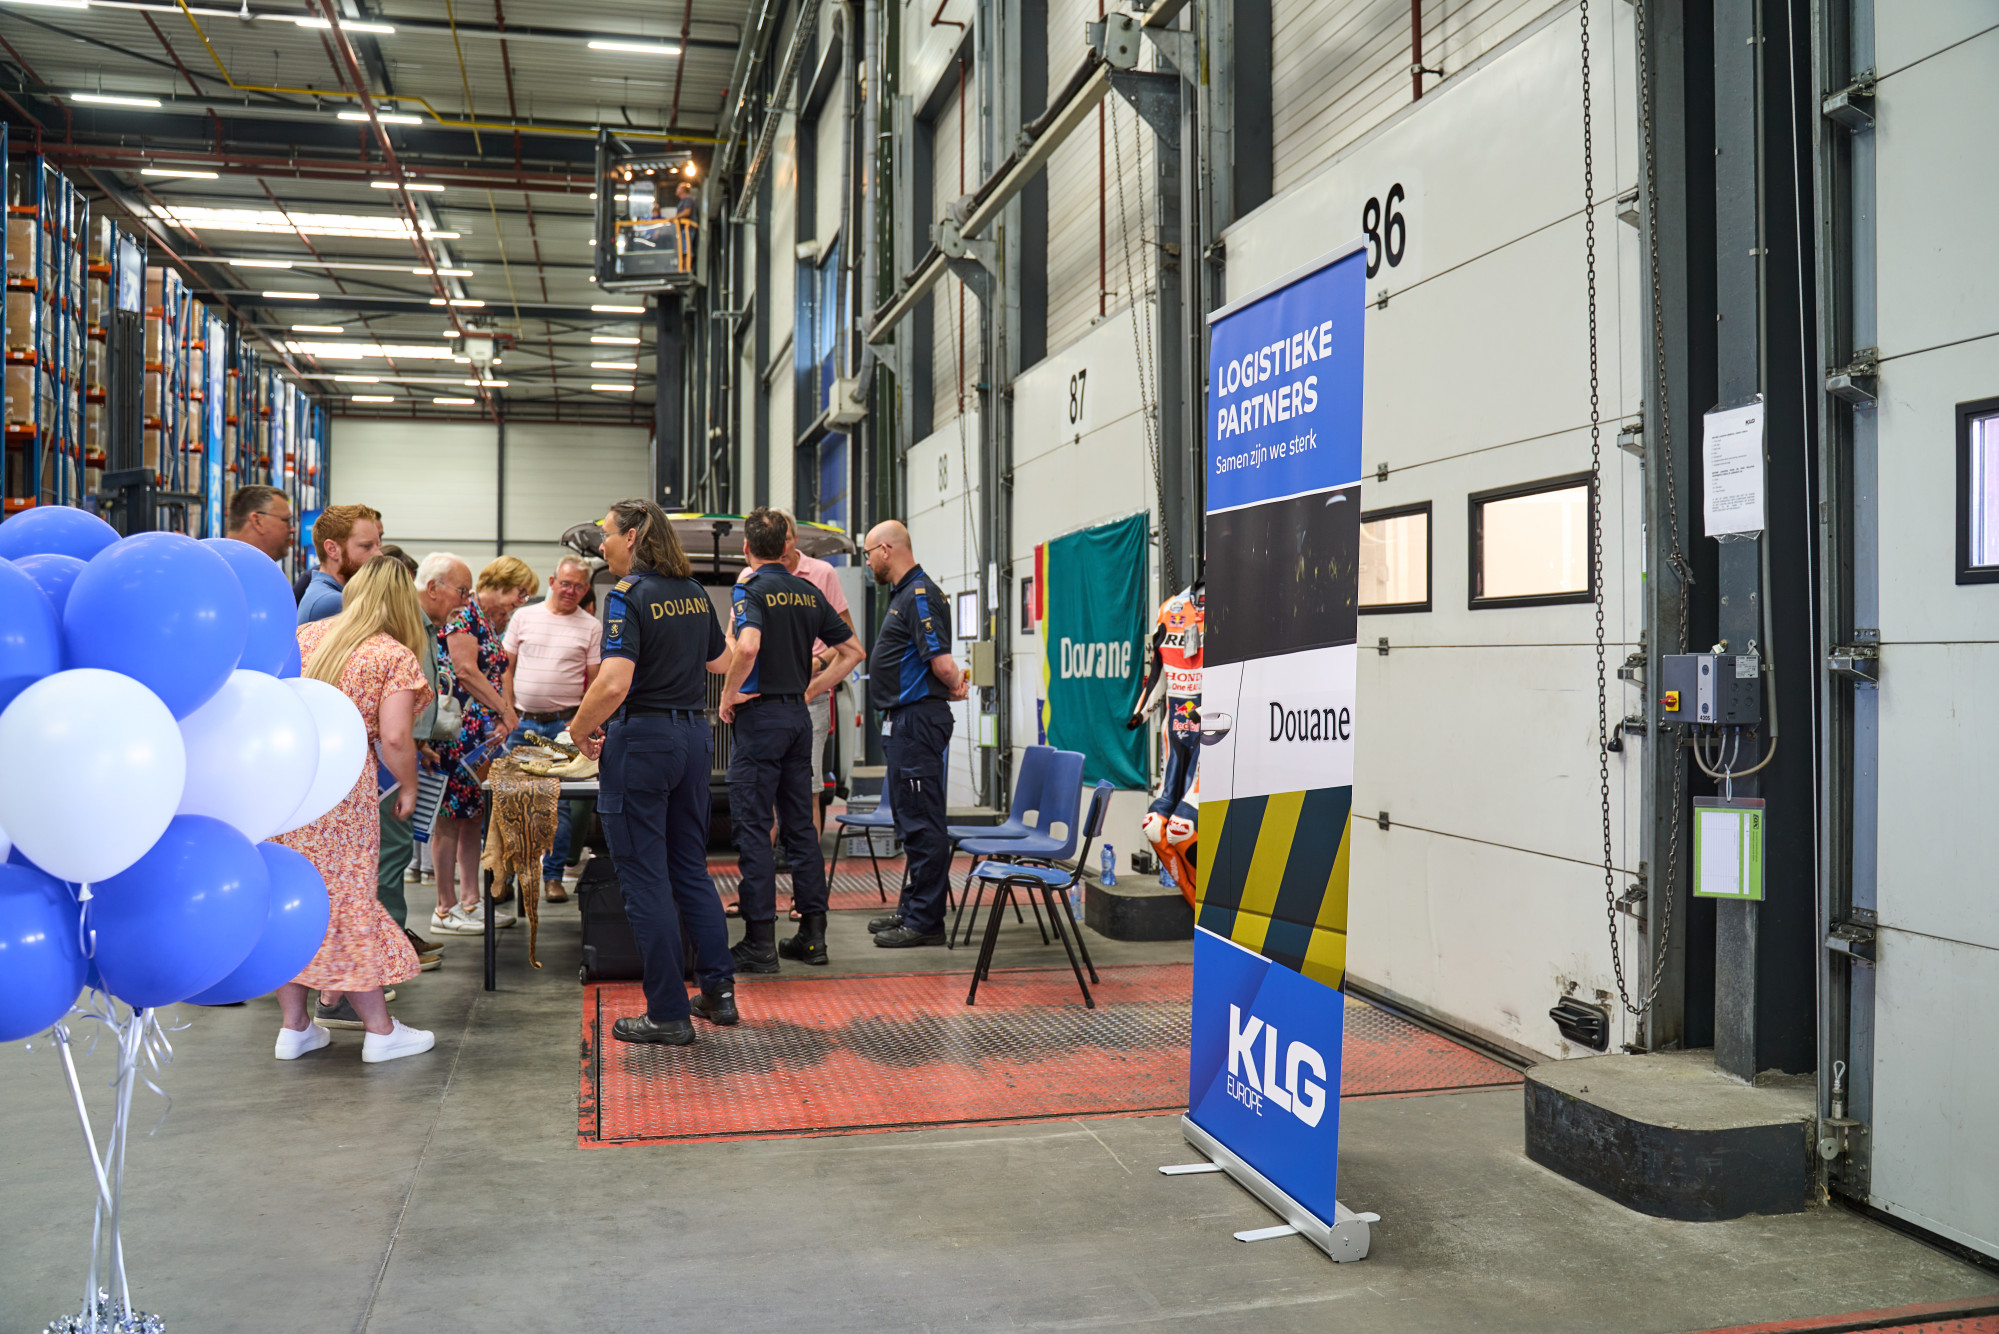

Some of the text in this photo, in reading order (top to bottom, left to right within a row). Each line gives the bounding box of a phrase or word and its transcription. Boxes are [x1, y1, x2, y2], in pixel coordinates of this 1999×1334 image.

[1363, 182, 1406, 279] 86
[1218, 320, 1333, 398] LOGISTIEKE
[1069, 368, 1087, 424] 87
[1217, 375, 1318, 441] PARTNERS
[938, 453, 949, 492] 88
[1216, 428, 1317, 475] Samen zijn we sterk
[1165, 671, 1203, 683] HOND
[1269, 701, 1351, 742] Douane
[1228, 1003, 1327, 1128] KLG
[1227, 1074, 1263, 1117] EUROPE
